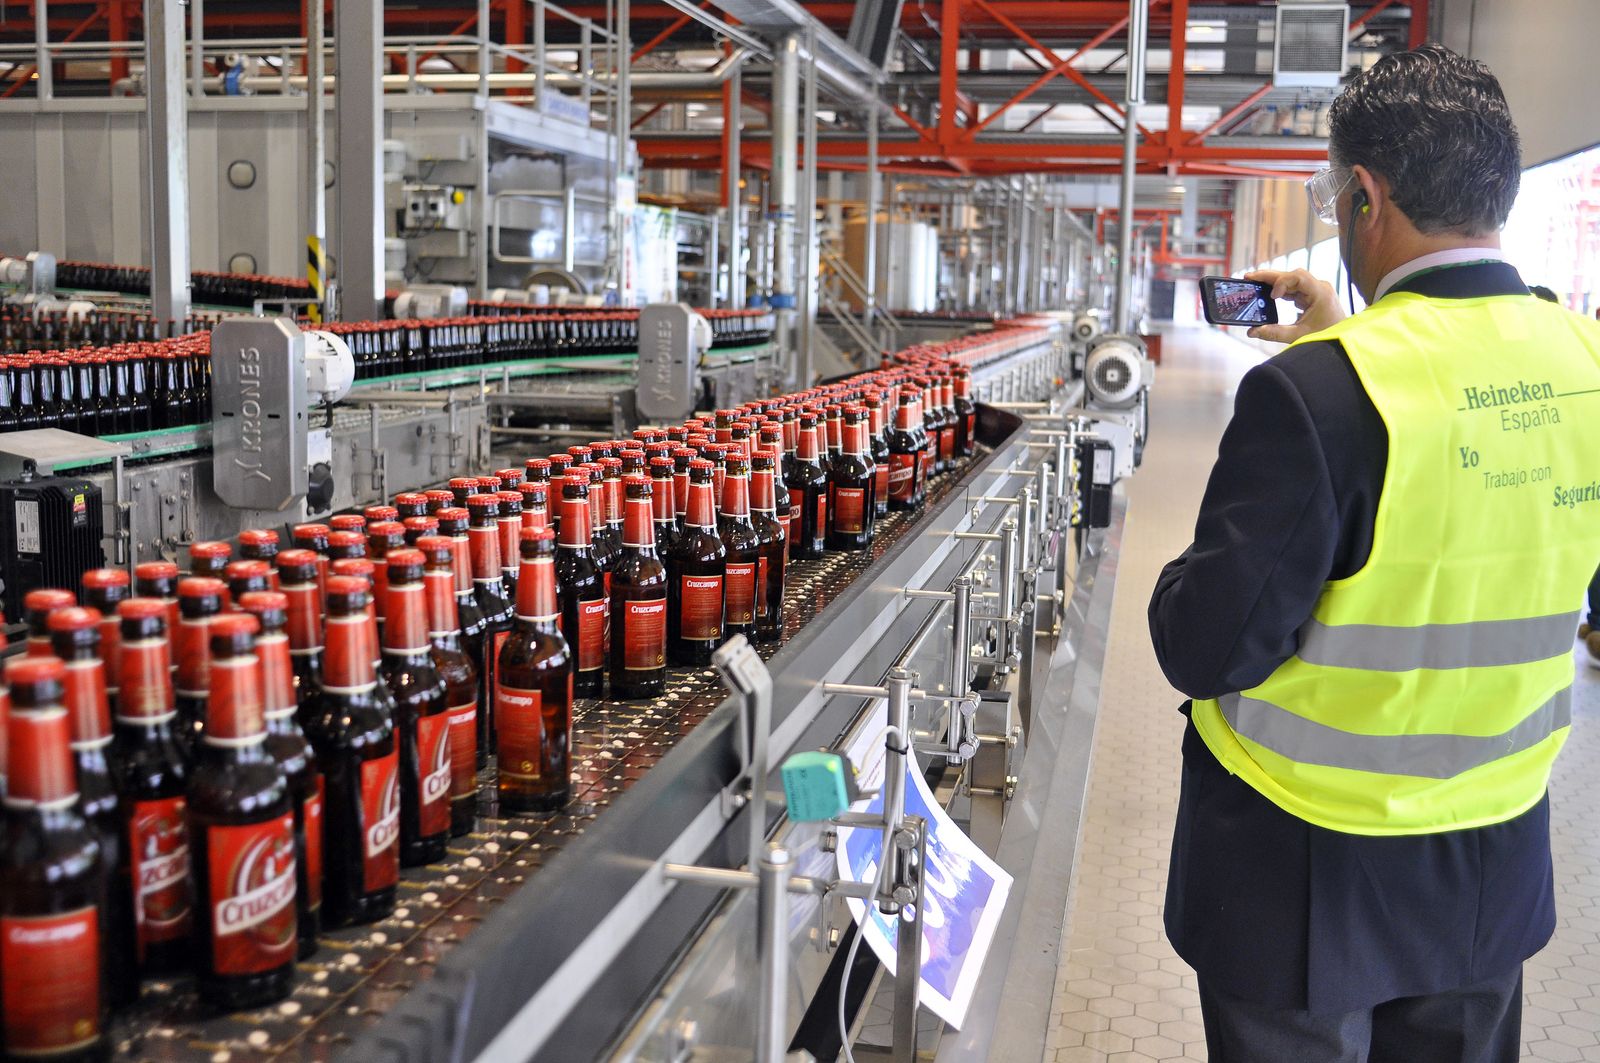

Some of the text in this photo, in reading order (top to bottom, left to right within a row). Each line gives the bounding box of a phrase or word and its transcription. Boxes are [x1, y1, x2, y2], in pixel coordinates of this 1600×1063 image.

[657, 320, 673, 384] KRONES
[241, 347, 262, 453] KRONES
[1464, 381, 1555, 409] Heineken
[1500, 403, 1561, 433] España
[1459, 446, 1480, 469] Yo
[1483, 466, 1552, 489] Trabajo con
